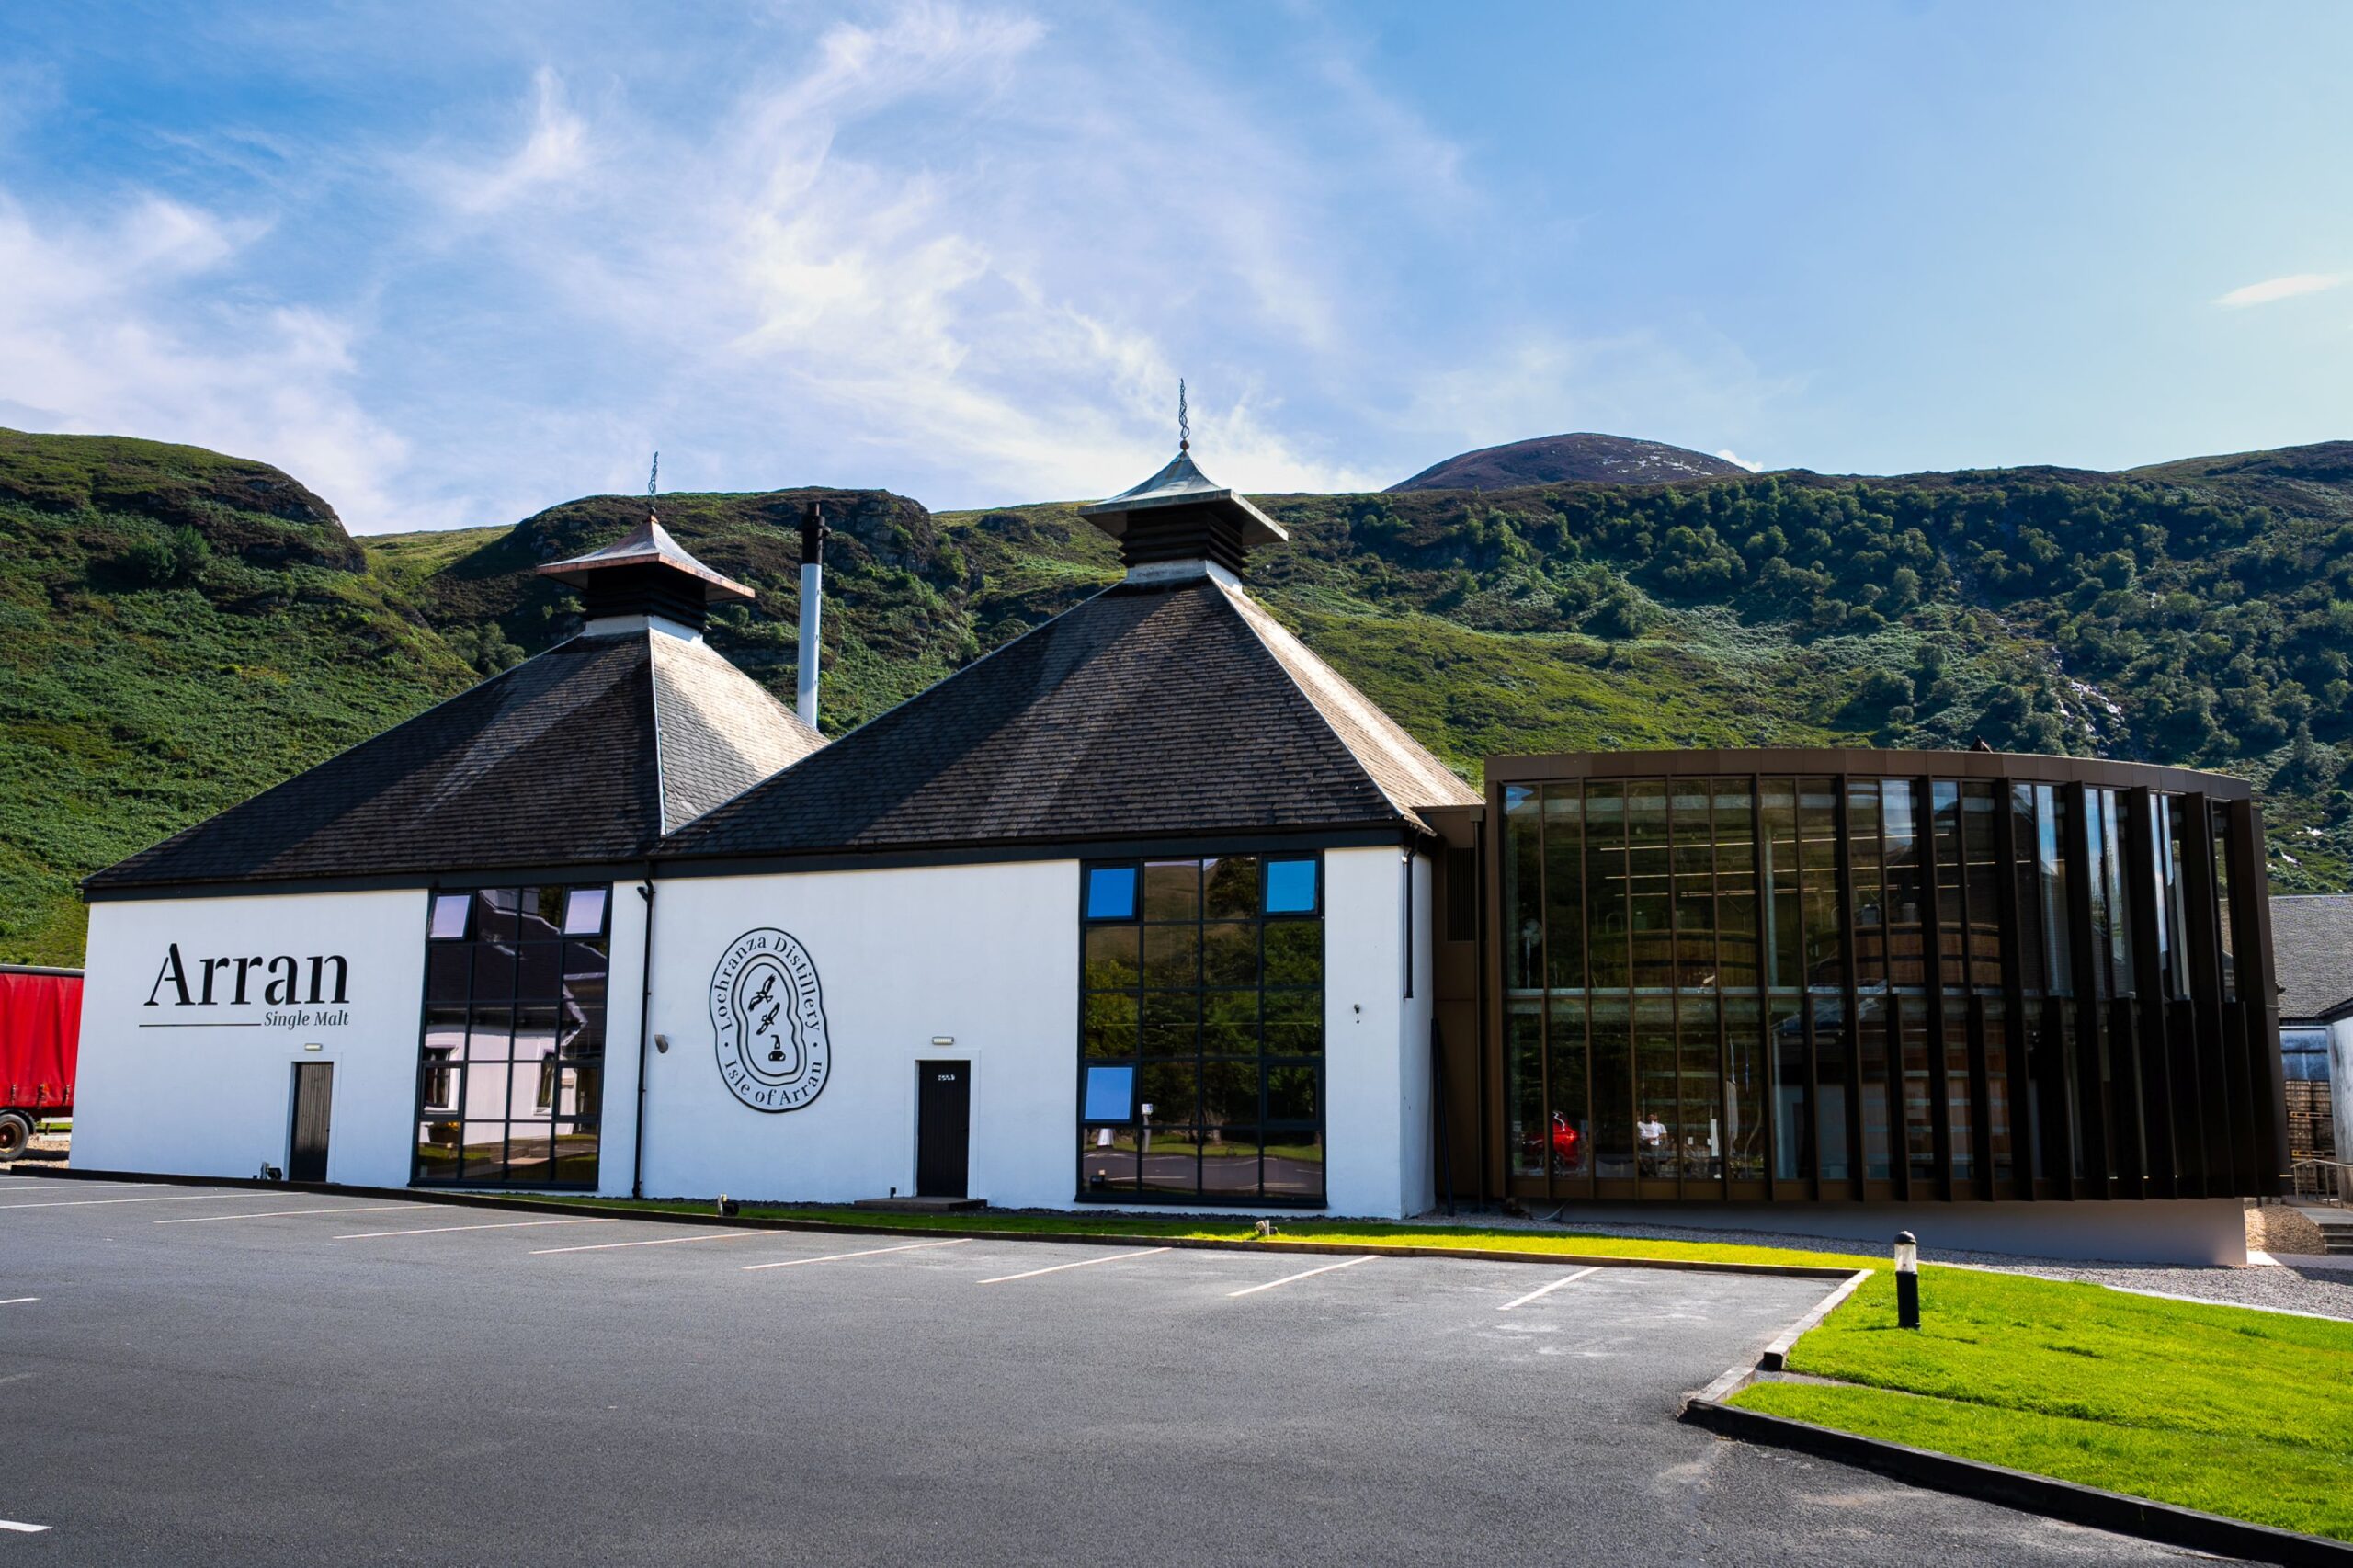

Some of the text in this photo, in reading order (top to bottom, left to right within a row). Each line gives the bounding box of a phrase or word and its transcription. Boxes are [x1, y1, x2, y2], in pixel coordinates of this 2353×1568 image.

[143, 942, 350, 1006] Arran
[714, 937, 821, 1032] Lochranza Distillery
[264, 1009, 350, 1030] Single Malt
[724, 1059, 823, 1106] Isle of Arran
